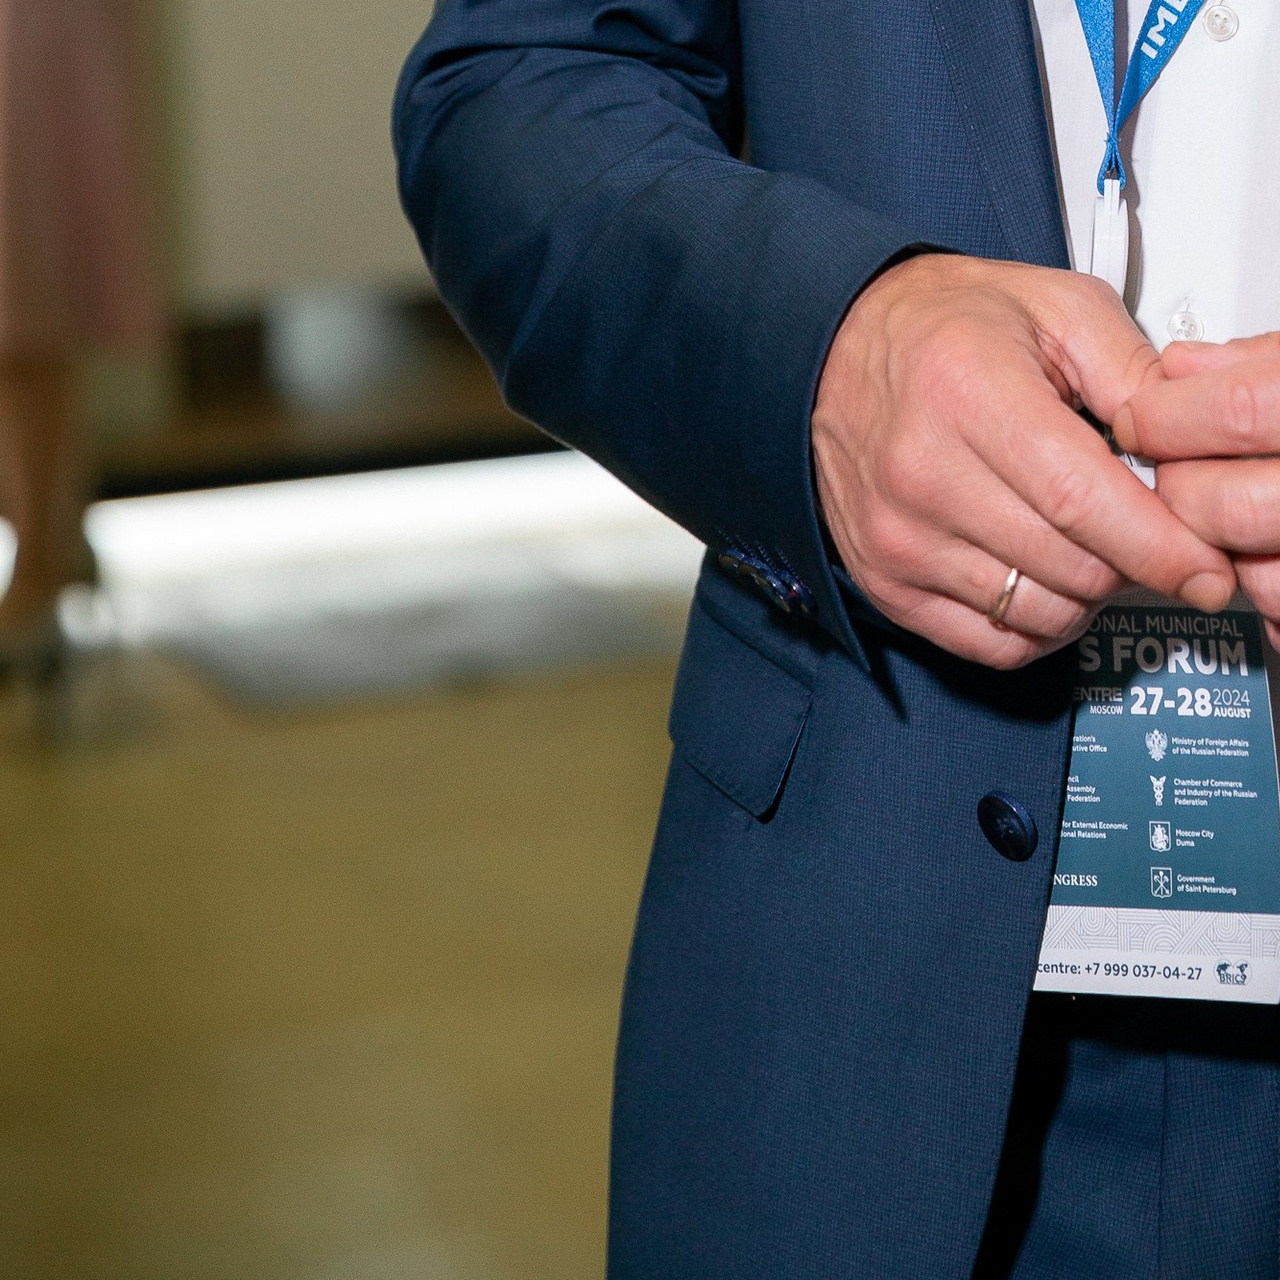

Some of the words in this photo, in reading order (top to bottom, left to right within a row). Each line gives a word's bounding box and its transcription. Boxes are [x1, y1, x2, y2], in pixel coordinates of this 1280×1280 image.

[1146, 614, 1244, 638] MUNICIPAL
[1113, 636, 1249, 677] FORUM
[1130, 685, 1212, 717] 27-28
[1213, 688, 1250, 707] 2024
[1090, 704, 1123, 715] MOSCOW
[1214, 706, 1252, 719] AUGUST
[1171, 737, 1196, 747] Ministry
[1197, 738, 1204, 746] of
[1089, 744, 1108, 753] Office
[1172, 747, 1179, 755] of
[1180, 747, 1190, 755] the
[1191, 747, 1215, 756] Russian
[1216, 748, 1249, 757] Federation
[1174, 778, 1201, 787] Chamber
[1202, 779, 1209, 787] of
[1210, 779, 1243, 789] Commerce
[1067, 794, 1101, 803] Federation
[1174, 788, 1186, 796] and
[1187, 788, 1213, 798] Industry
[1214, 789, 1221, 797] of
[1221, 789, 1232, 798] the
[1233, 790, 1258, 799] Russian
[1174, 797, 1208, 807] Federation
[1072, 820, 1098, 829] External
[1099, 822, 1128, 830] Economic
[1078, 830, 1106, 839] Relations
[1175, 829, 1200, 837] Moscow
[1201, 830, 1214, 839] City
[1176, 839, 1195, 847] Duma
[1053, 874, 1098, 887] NGRESS
[1177, 874, 1215, 883] Government
[1177, 884, 1184, 892] of
[1185, 884, 1201, 893] Saint
[1202, 885, 1237, 896] Petersburg
[1037, 961, 1081, 975] centre:
[1085, 962, 1100, 976] +7
[1104, 963, 1129, 977] 999
[1132, 964, 1203, 981] 037-04-27
